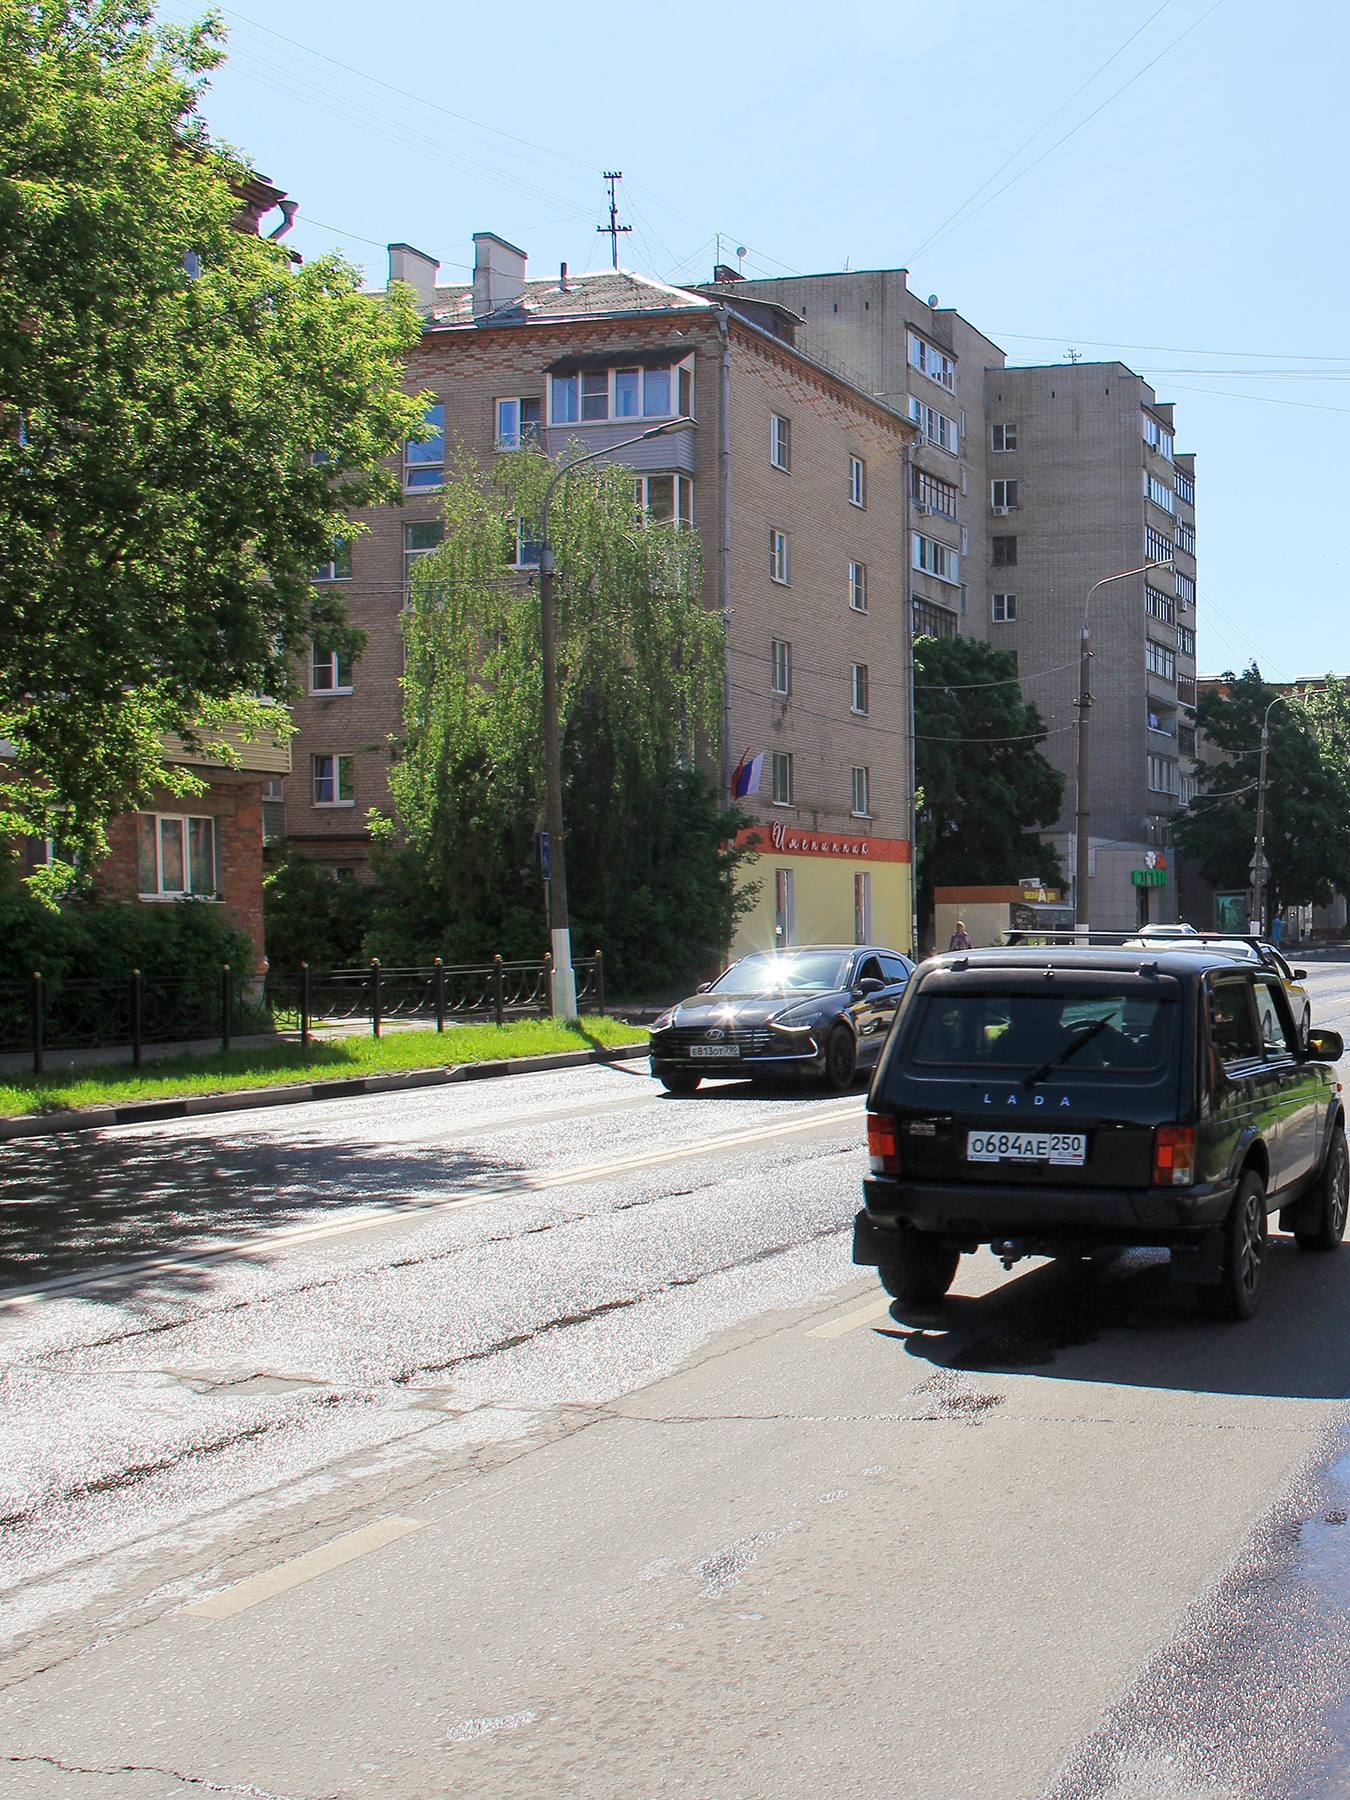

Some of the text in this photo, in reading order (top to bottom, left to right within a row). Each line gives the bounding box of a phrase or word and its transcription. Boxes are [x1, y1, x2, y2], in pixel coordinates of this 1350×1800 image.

[772, 821, 869, 855] Именинник
[983, 1094, 1070, 1106] LADA
[972, 1134, 1081, 1155] О684АЕ 250
